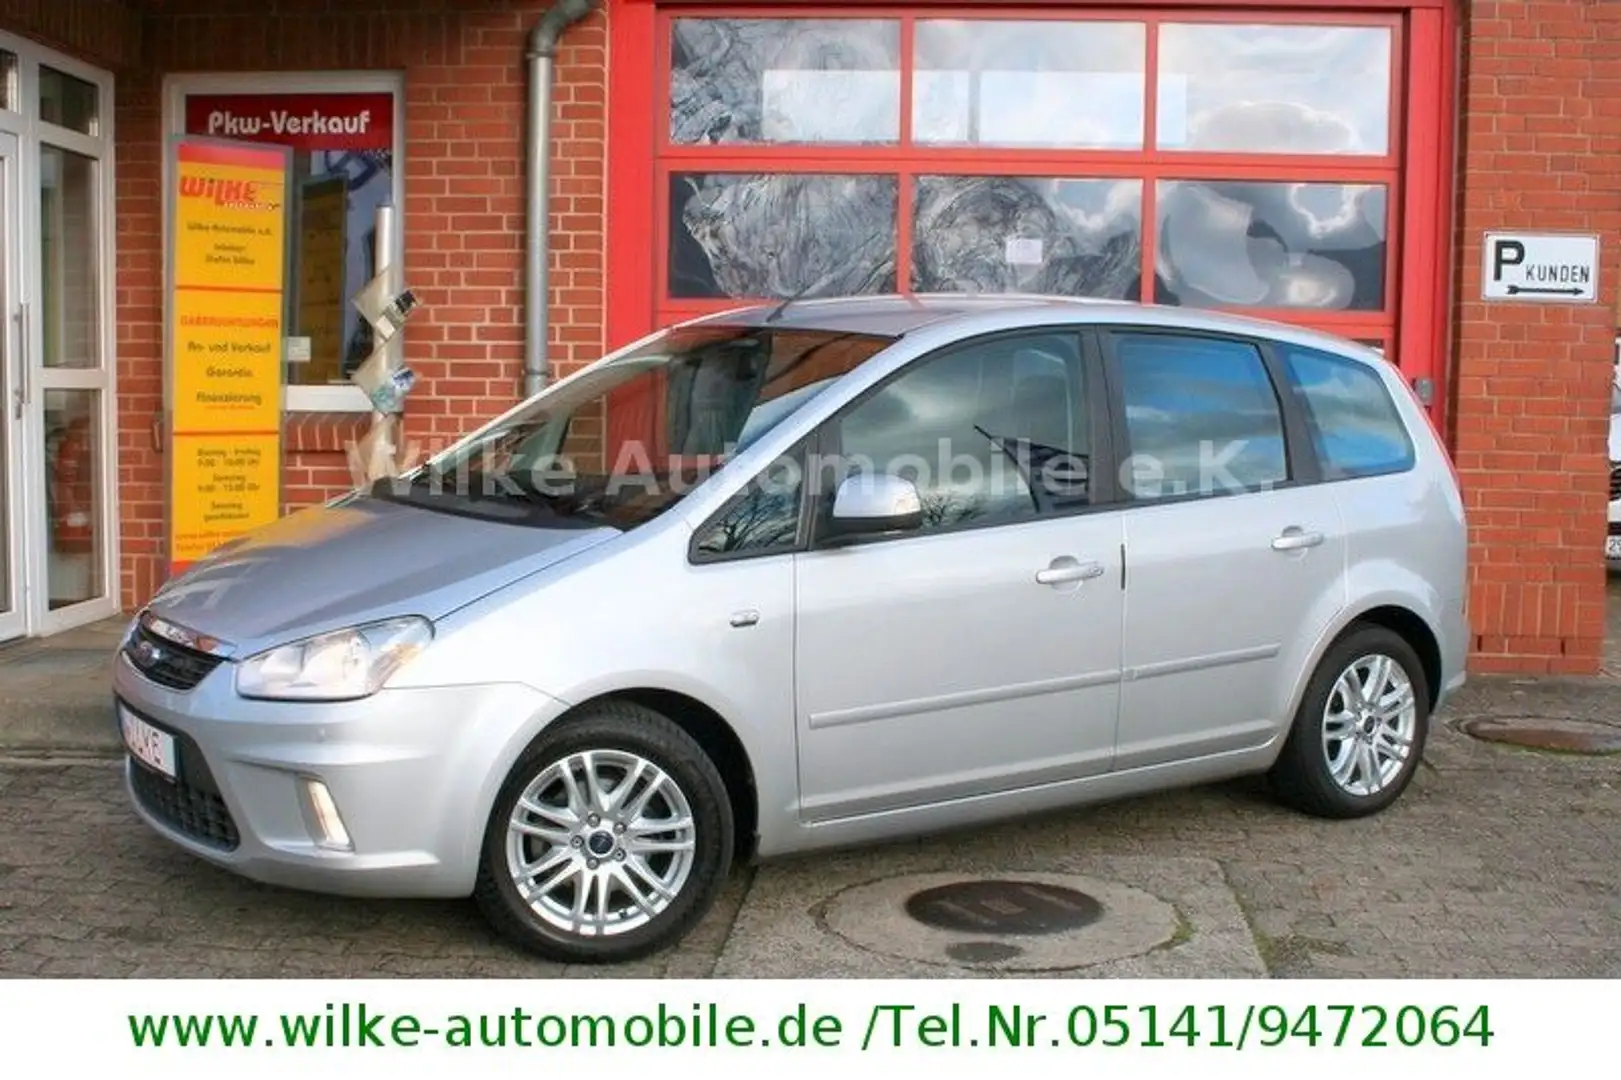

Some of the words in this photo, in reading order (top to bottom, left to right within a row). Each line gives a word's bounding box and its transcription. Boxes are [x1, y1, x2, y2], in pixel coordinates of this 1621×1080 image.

[208, 109, 371, 135] Pkw-Verkauf
[1494, 240, 1525, 281] P
[1525, 264, 1590, 283] KUNDEN
